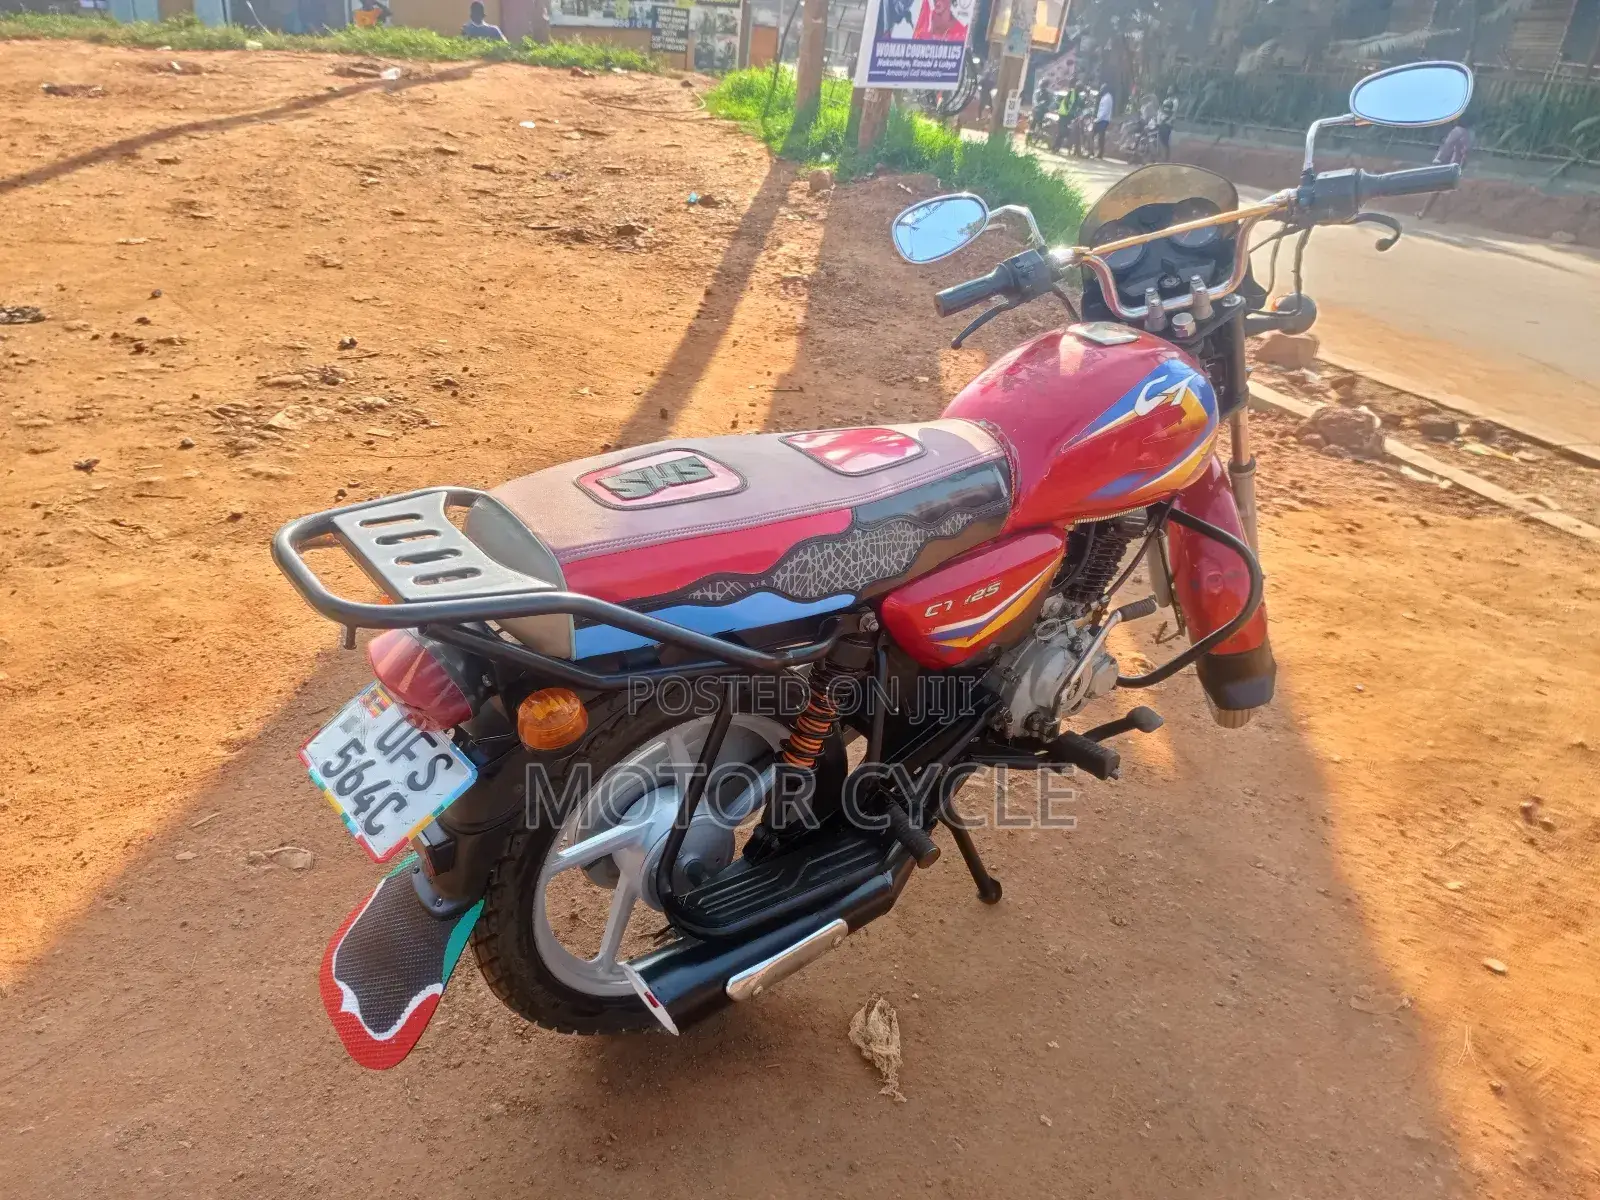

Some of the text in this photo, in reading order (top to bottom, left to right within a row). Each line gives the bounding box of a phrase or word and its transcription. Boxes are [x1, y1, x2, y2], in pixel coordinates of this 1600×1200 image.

[876, 43, 905, 58] WOMAN
[906, 44, 948, 59] COUNCILLOR
[321, 737, 408, 836] 564C
[376, 713, 454, 792] UFS
